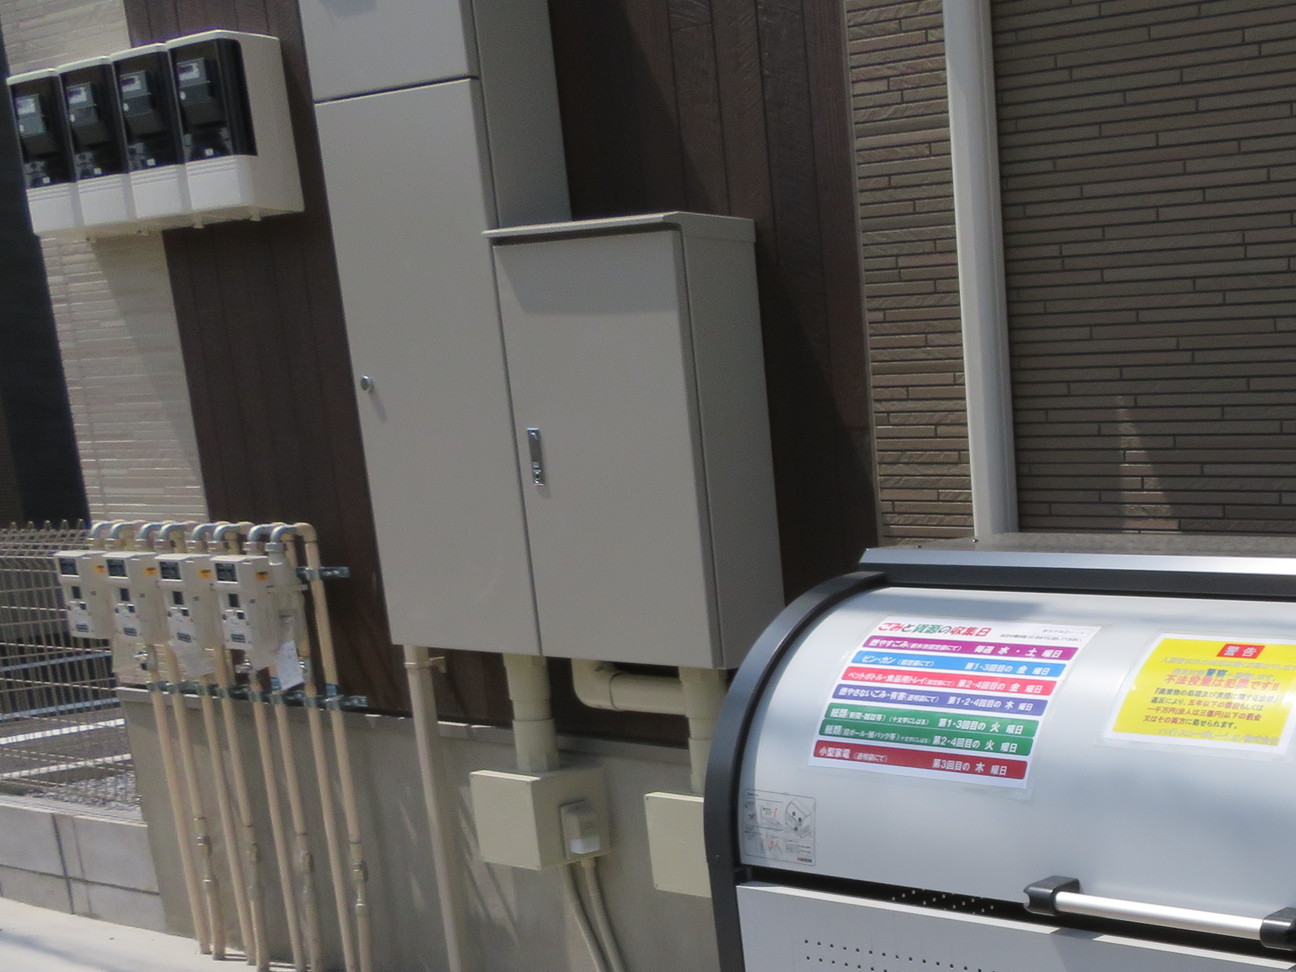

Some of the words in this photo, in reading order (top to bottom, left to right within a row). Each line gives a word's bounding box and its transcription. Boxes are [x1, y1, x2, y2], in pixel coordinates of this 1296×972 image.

[878, 622, 992, 637] ごみと資源の収集日
[1223, 645, 1257, 657] 警告
[1005, 724, 1024, 735] 曜日
[1000, 742, 1018, 753] 曜日
[990, 764, 1008, 775] 曜日
